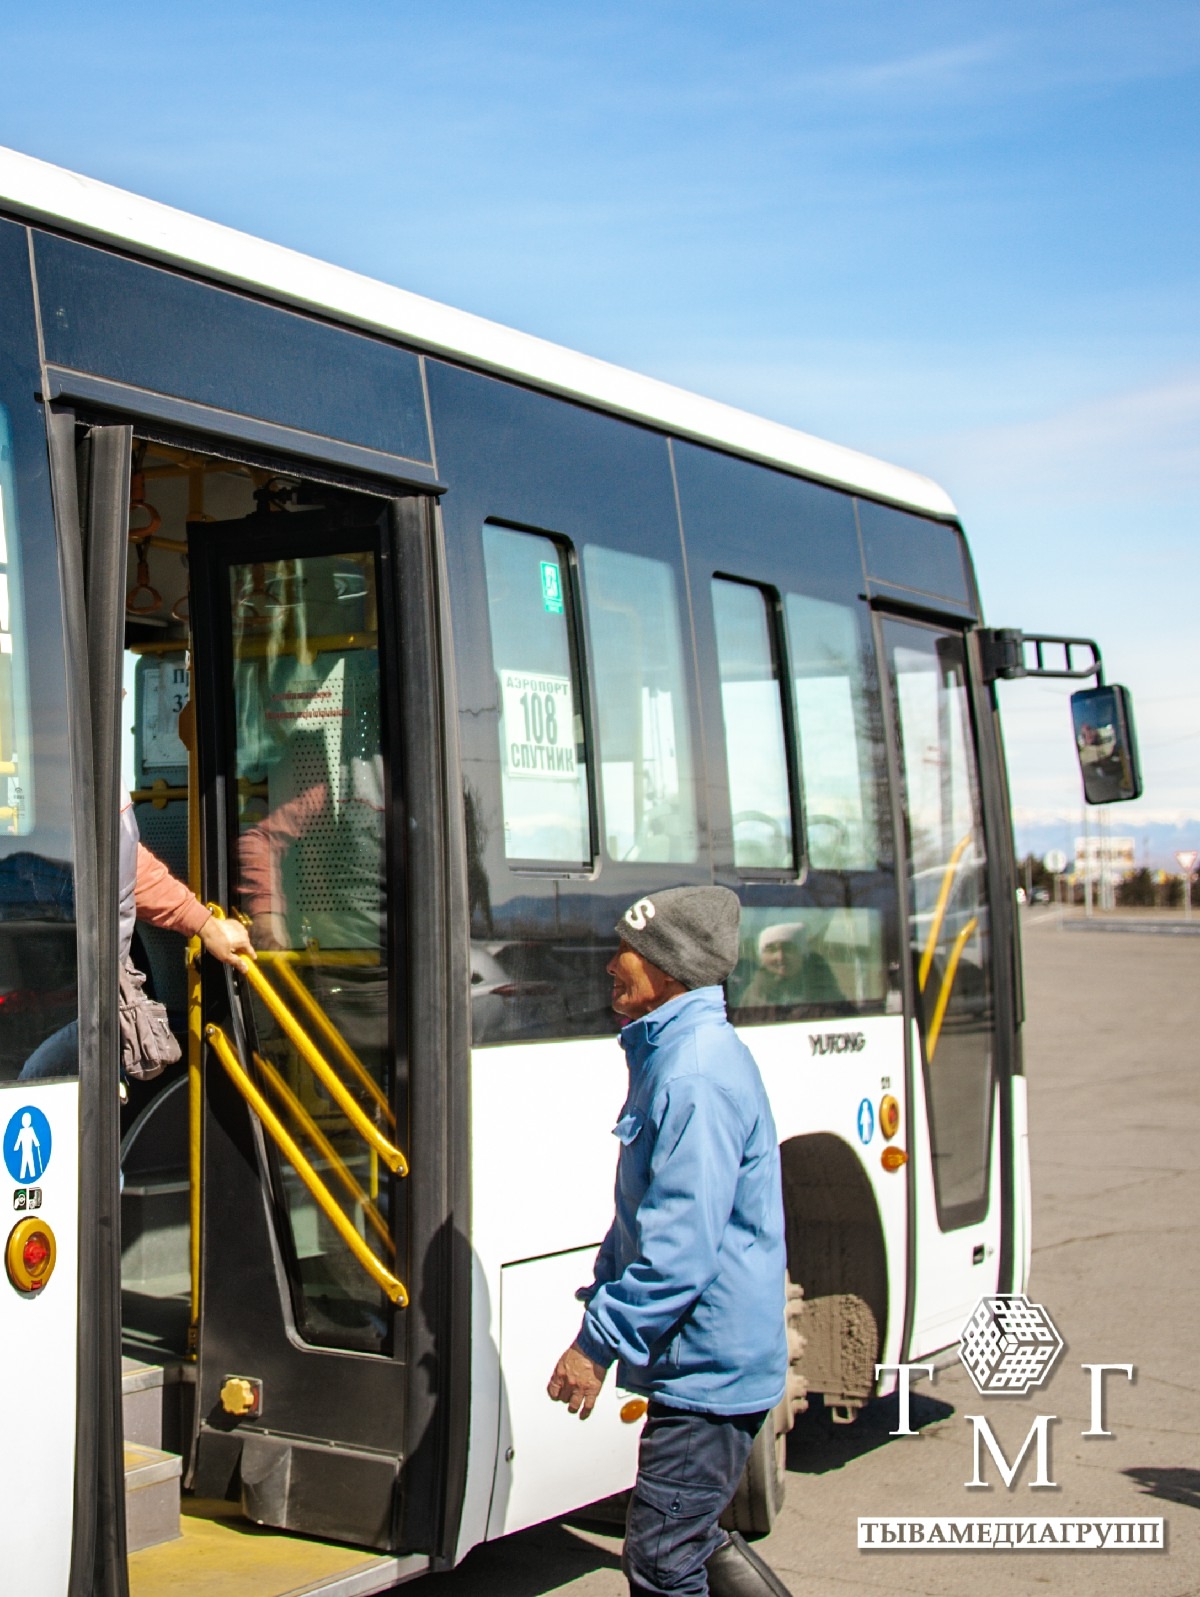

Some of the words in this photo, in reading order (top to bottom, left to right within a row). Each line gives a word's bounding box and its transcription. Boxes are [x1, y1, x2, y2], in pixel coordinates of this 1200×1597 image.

[506, 676, 569, 696] АЭРОПОРТ
[520, 692, 558, 745] 108
[510, 742, 575, 773] СПУТНИК
